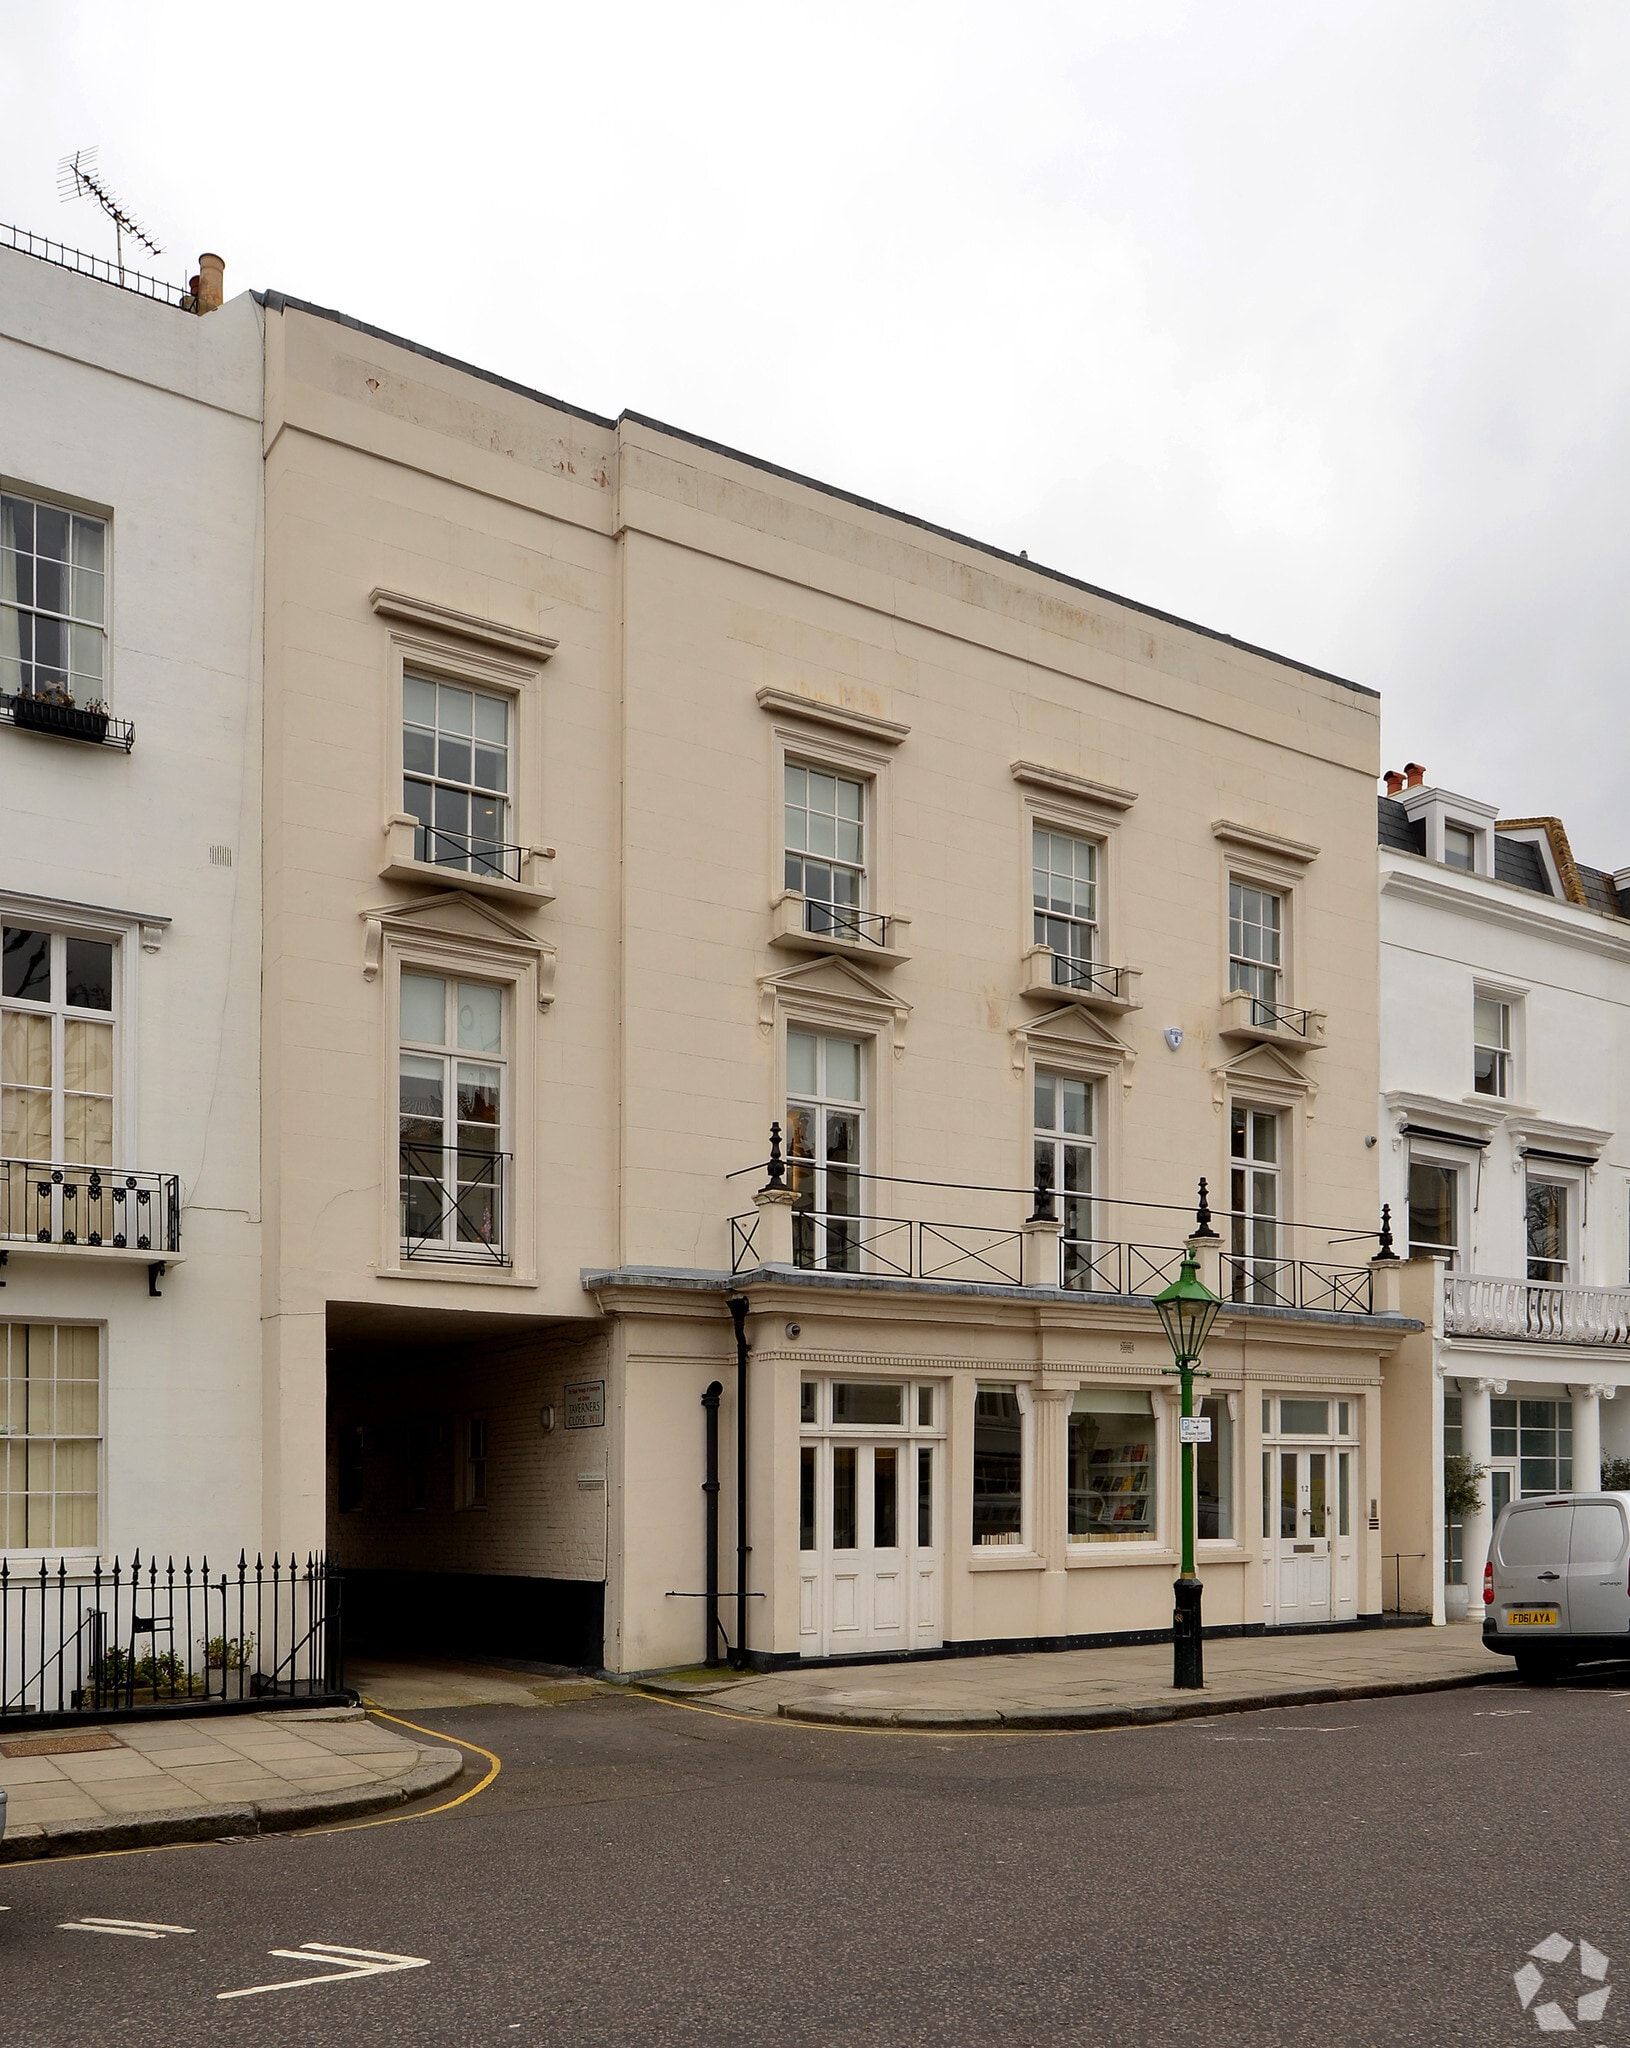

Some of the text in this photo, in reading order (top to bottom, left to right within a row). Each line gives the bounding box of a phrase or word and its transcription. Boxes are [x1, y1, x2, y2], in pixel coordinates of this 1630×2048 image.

[568, 1401, 600, 1414] TAVERNERS
[1512, 1613, 1551, 1623] FD61 AYA
